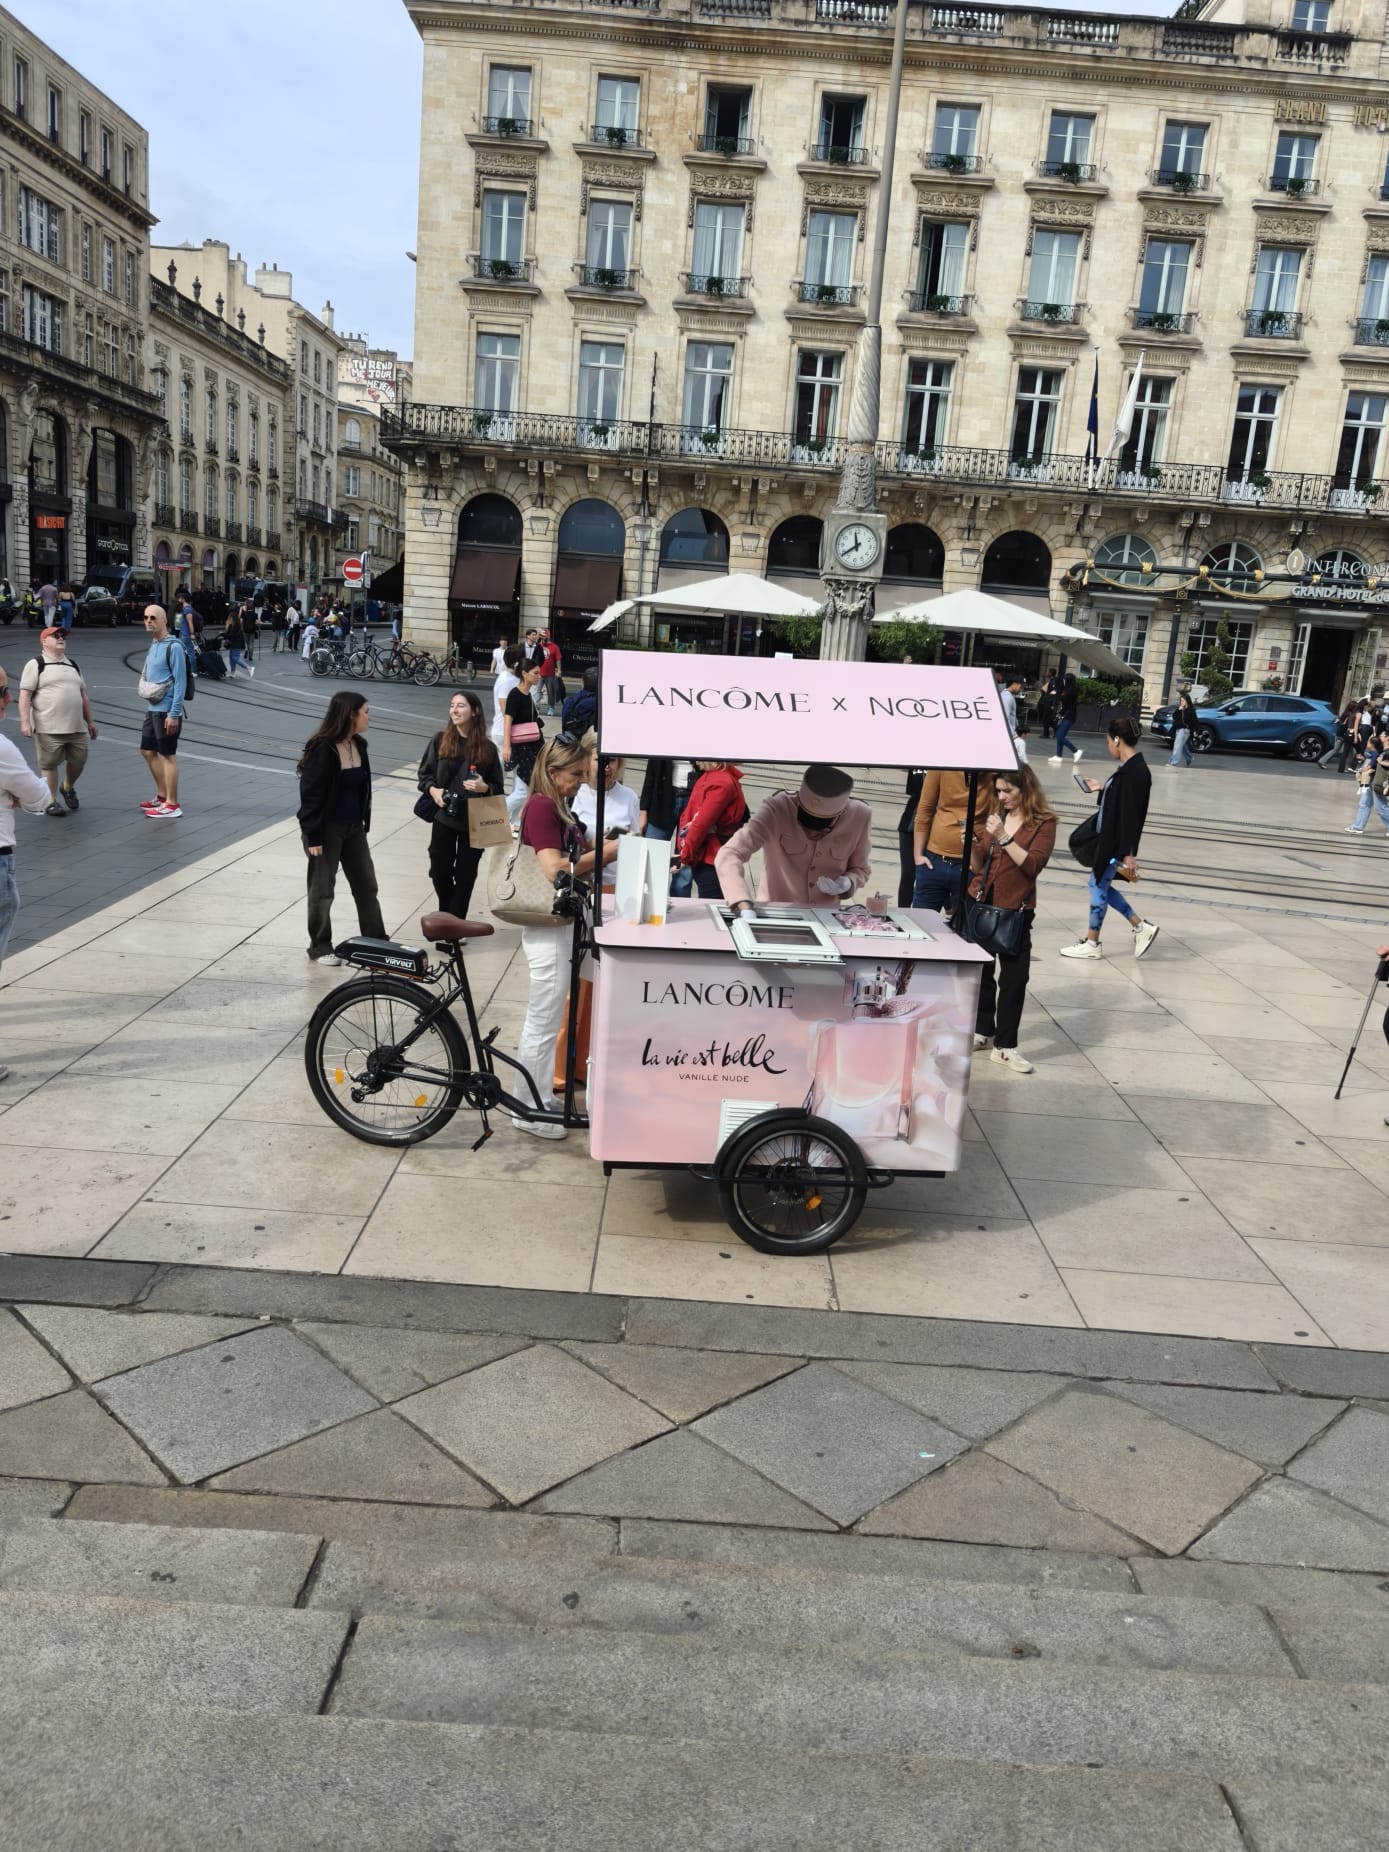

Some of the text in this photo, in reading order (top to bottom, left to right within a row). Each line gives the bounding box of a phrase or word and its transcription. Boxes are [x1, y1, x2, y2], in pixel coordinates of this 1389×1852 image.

[352, 359, 393, 370] TU REND
[1292, 585, 1333, 599] GRAND
[615, 684, 811, 713] LANCÔME
[868, 695, 993, 721] NOCIBÉ
[642, 979, 795, 1009] LANCÔME
[665, 1049, 689, 1066] vie
[692, 1040, 721, 1066] est
[721, 1033, 788, 1075] belle
[678, 1073, 750, 1083] VANILLE NUDE
